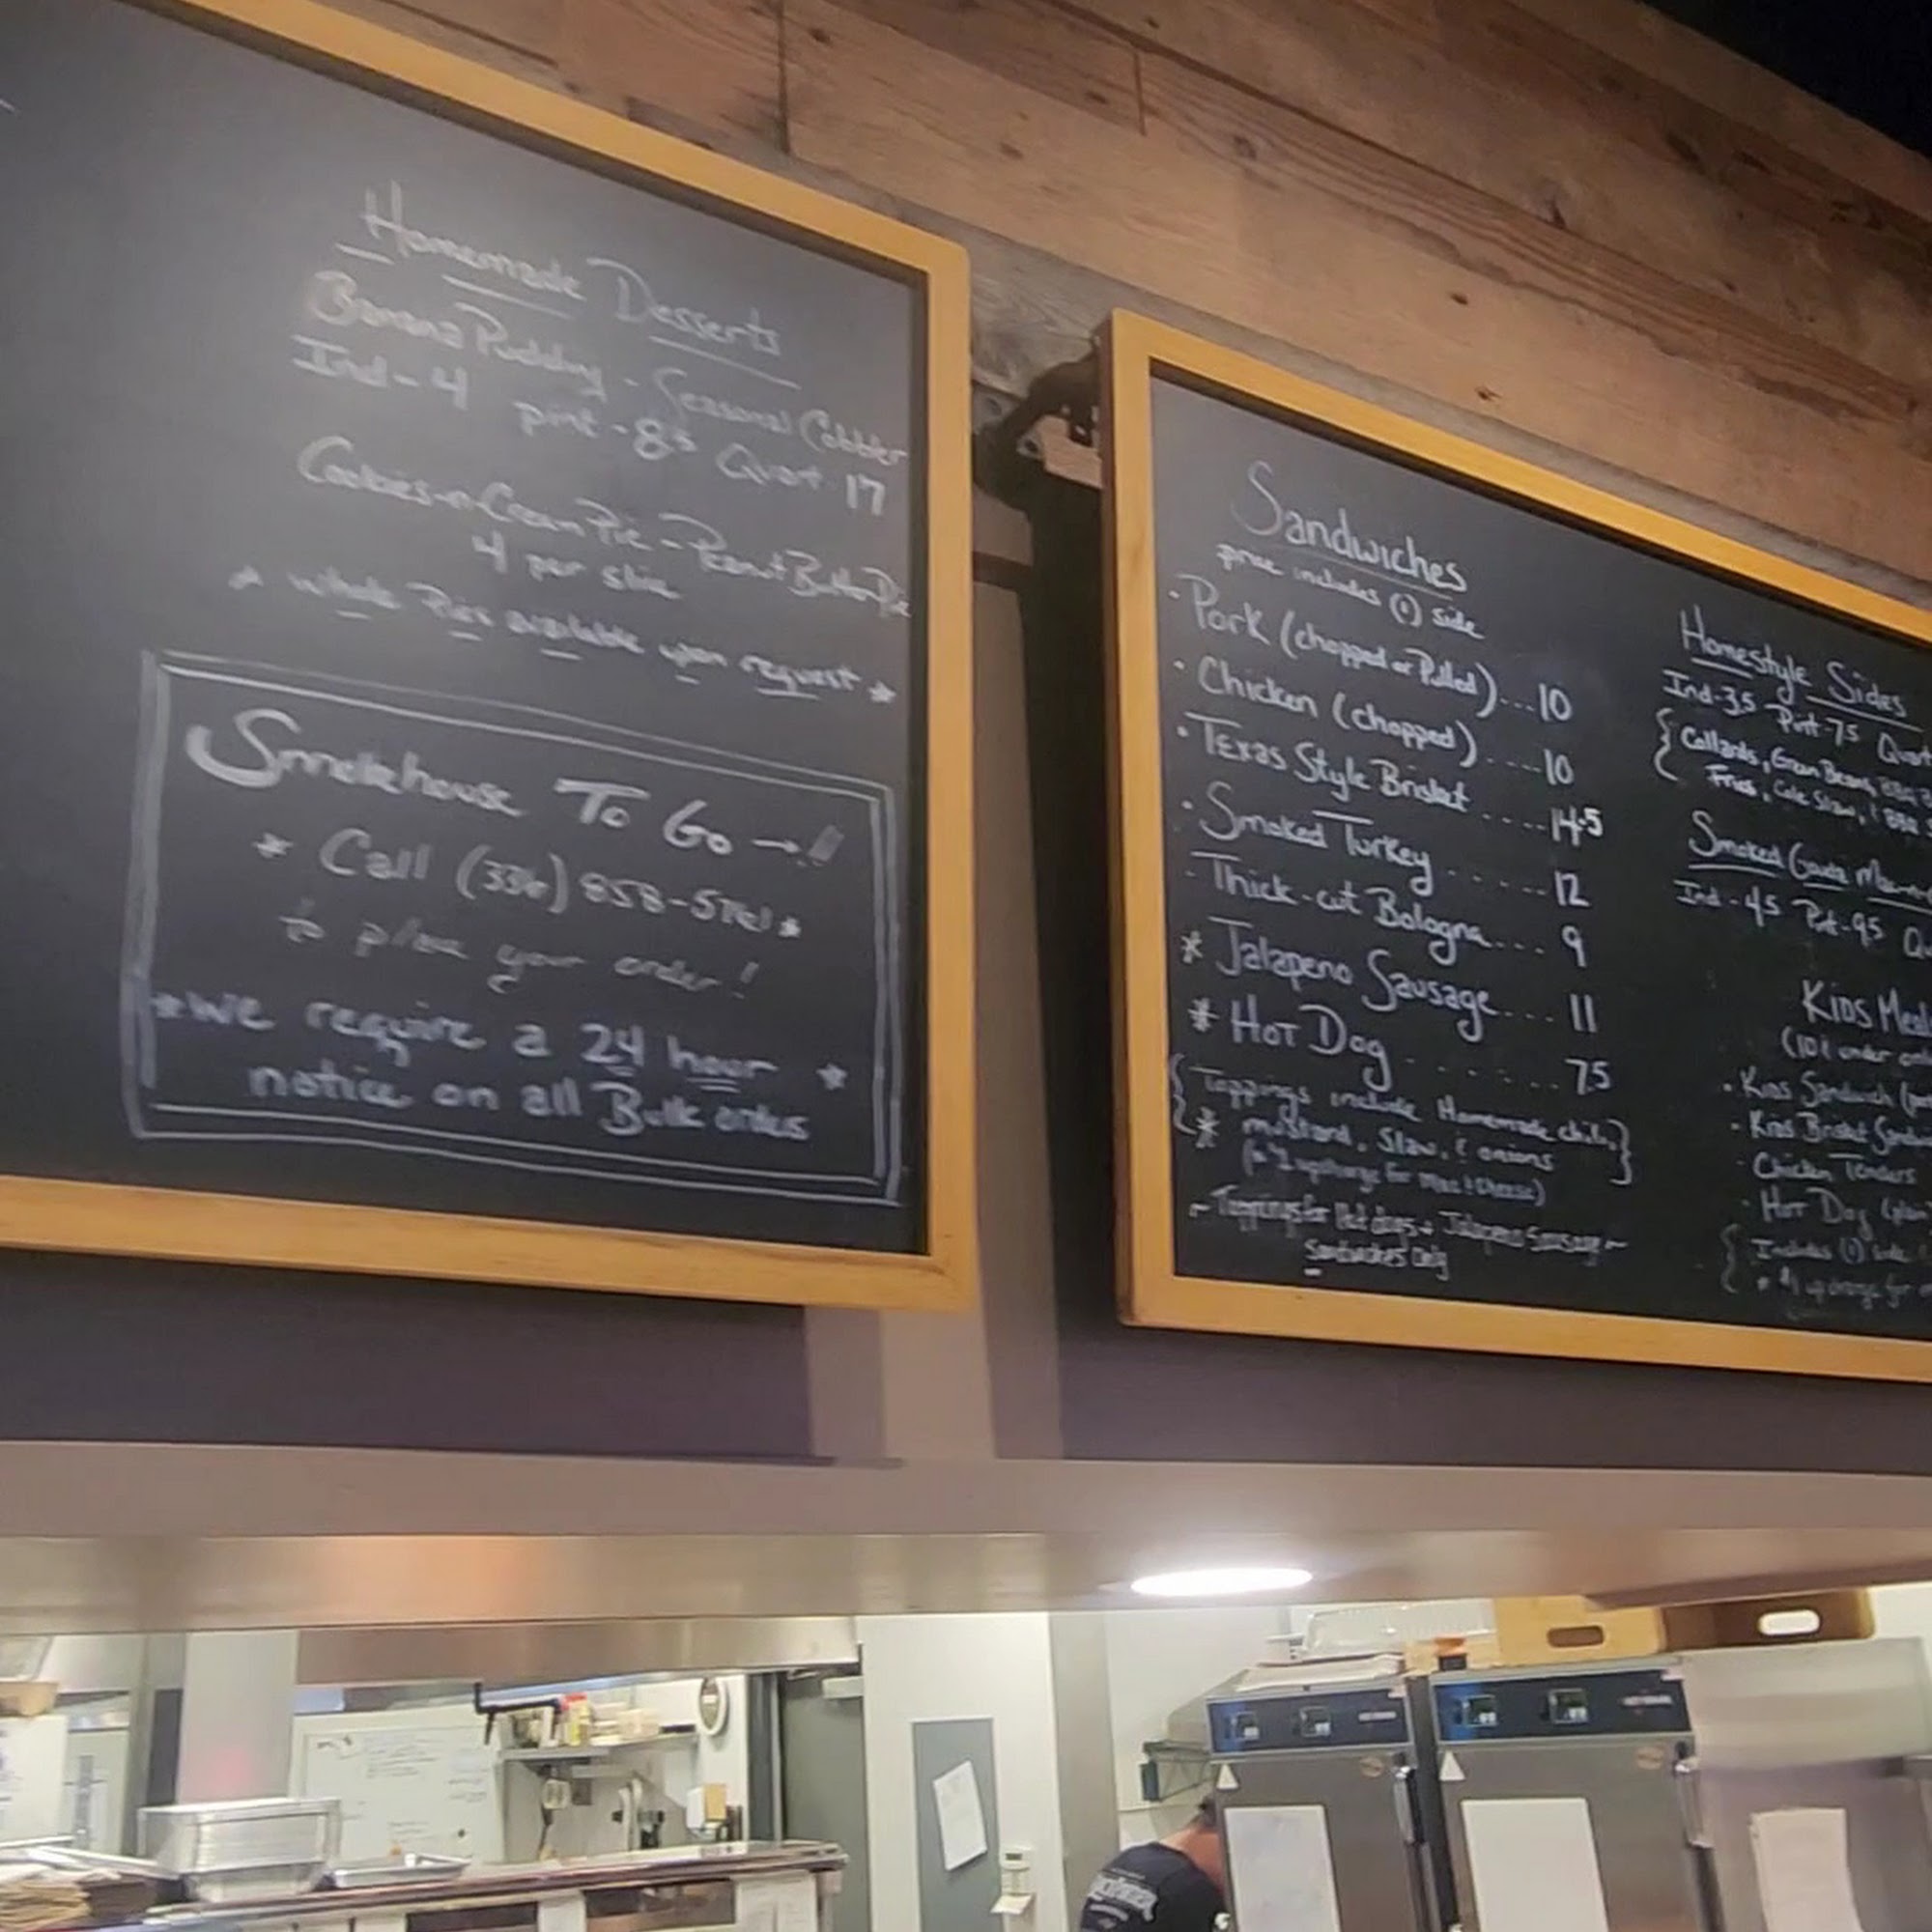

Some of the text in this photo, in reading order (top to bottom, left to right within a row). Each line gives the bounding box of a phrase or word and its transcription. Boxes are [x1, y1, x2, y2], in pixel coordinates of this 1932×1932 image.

[585, 258, 781, 357] Desserts
[845, 472, 887, 517] 17
[1230, 460, 1467, 593] Sandwiches
[471, 530, 508, 575] 4
[1177, 572, 1272, 646] Pork
[1538, 682, 1573, 723] 10
[1679, 604, 1908, 719] Homestyle Sides
[1198, 655, 1319, 719] Chicken
[1543, 748, 1576, 786] 10
[185, 707, 733, 856] Smokehouse To Go
[1293, 741, 1373, 804] Style
[1369, 758, 1471, 813] Brisket
[319, 827, 432, 880] Call
[1199, 781, 1592, 909] Smoked Turkey 12
[1688, 809, 1785, 869] Smoked
[1208, 915, 1598, 1043] Jalapeno Sausage 11
[1560, 924, 1587, 967] 9
[303, 998, 488, 1067] require
[511, 1021, 554, 1058] a
[579, 1021, 645, 1068] 24
[667, 1034, 780, 1079] hour
[1298, 1003, 1392, 1094] Dog
[248, 1059, 416, 1110] notice
[432, 1081, 501, 1111] on
[519, 1075, 582, 1118] all
